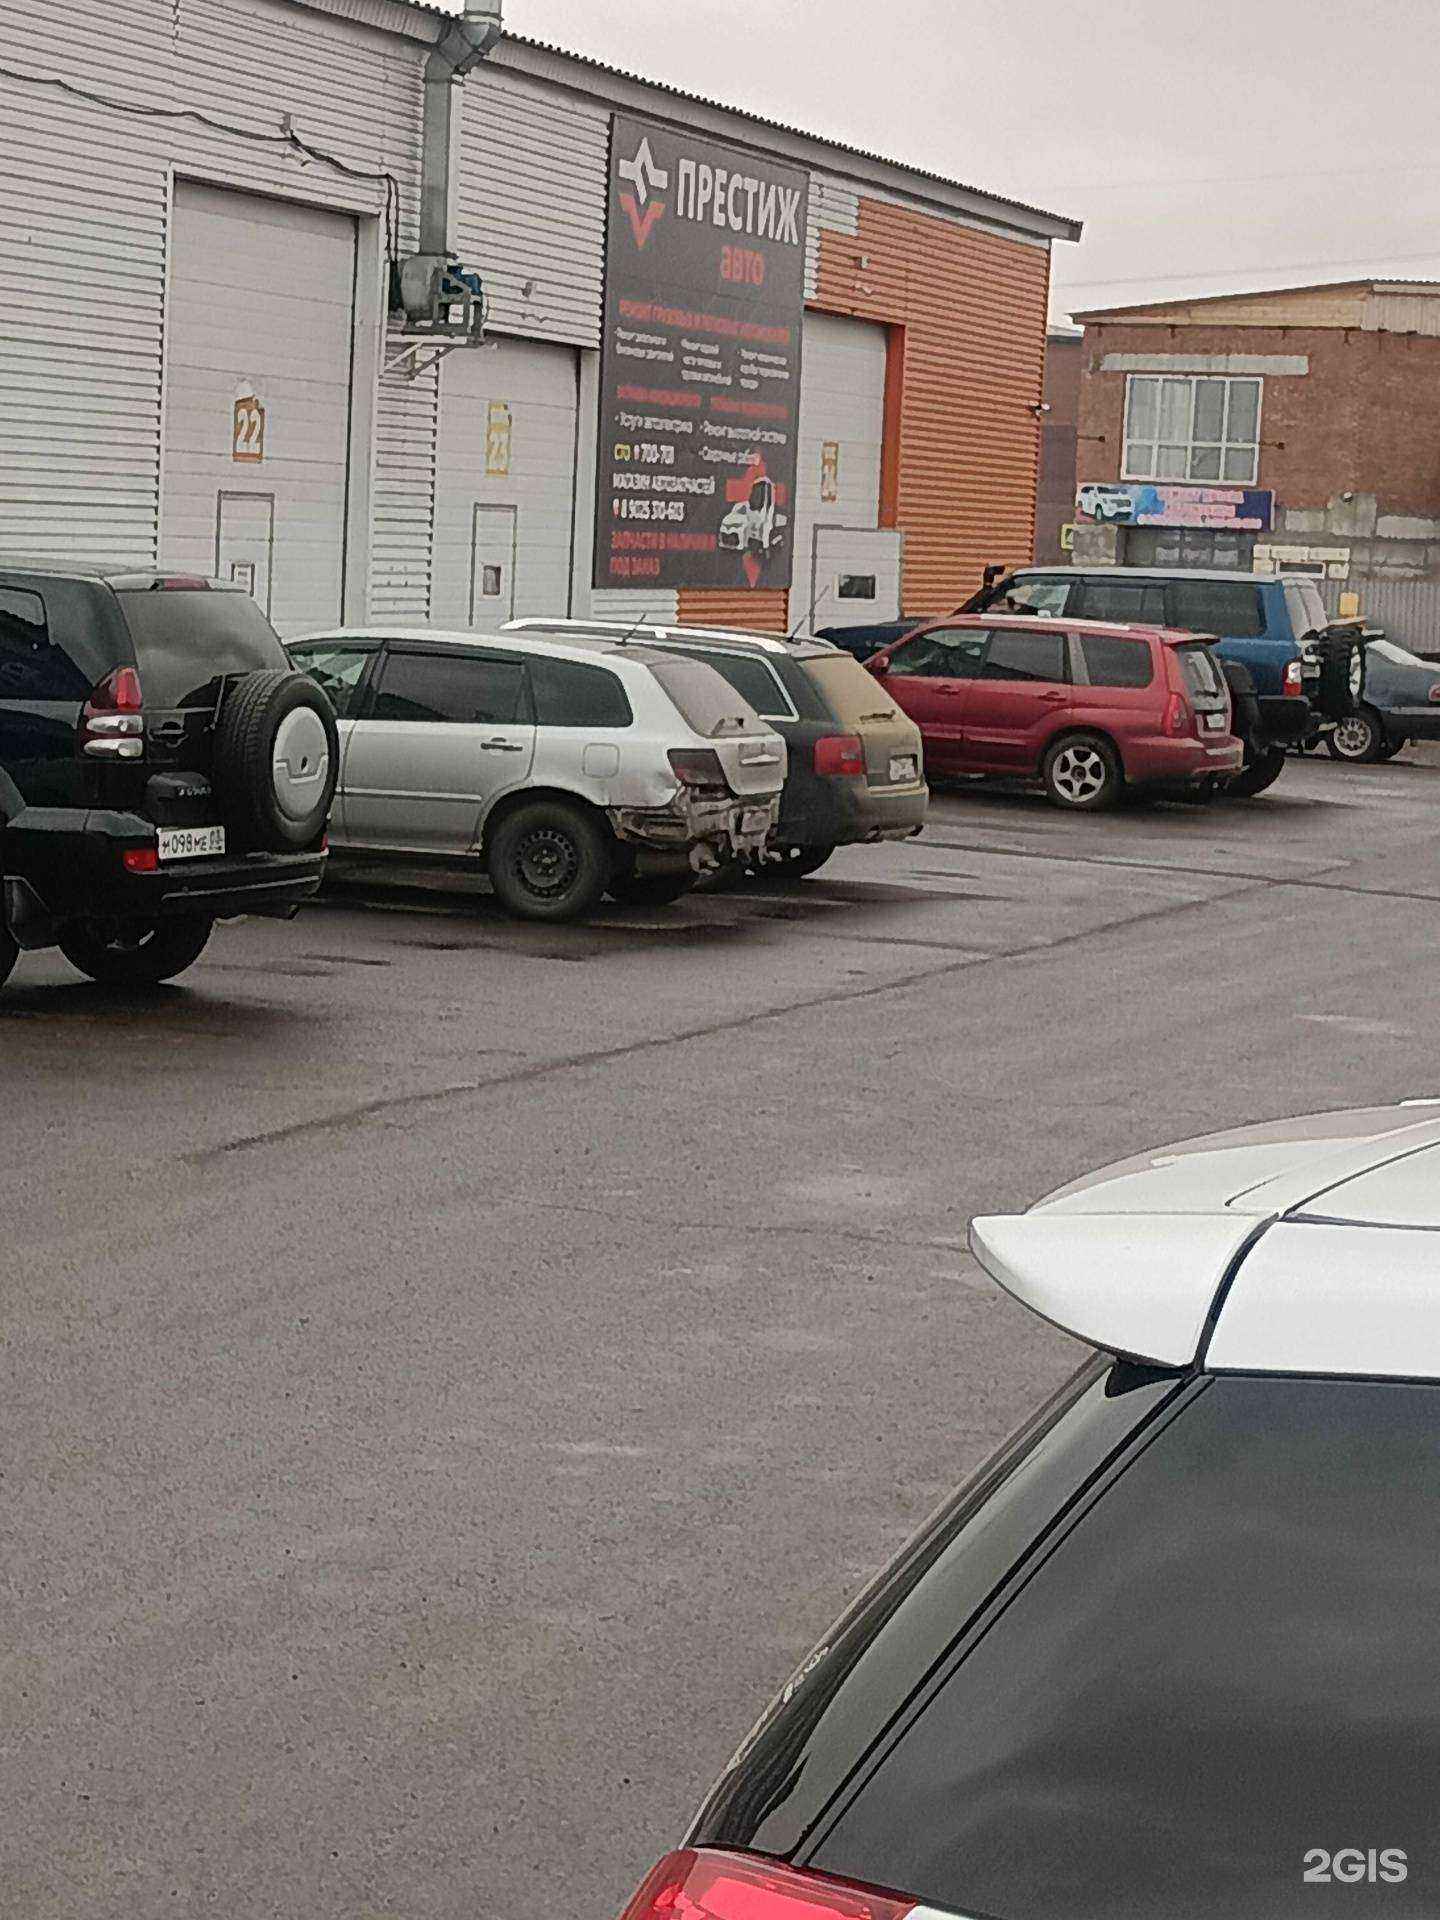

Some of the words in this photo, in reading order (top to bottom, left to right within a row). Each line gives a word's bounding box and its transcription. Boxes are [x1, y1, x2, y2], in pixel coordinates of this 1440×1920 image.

[677, 158, 801, 246] ПРЕСТИЖ
[720, 245, 765, 286] авто
[235, 408, 262, 455] 22
